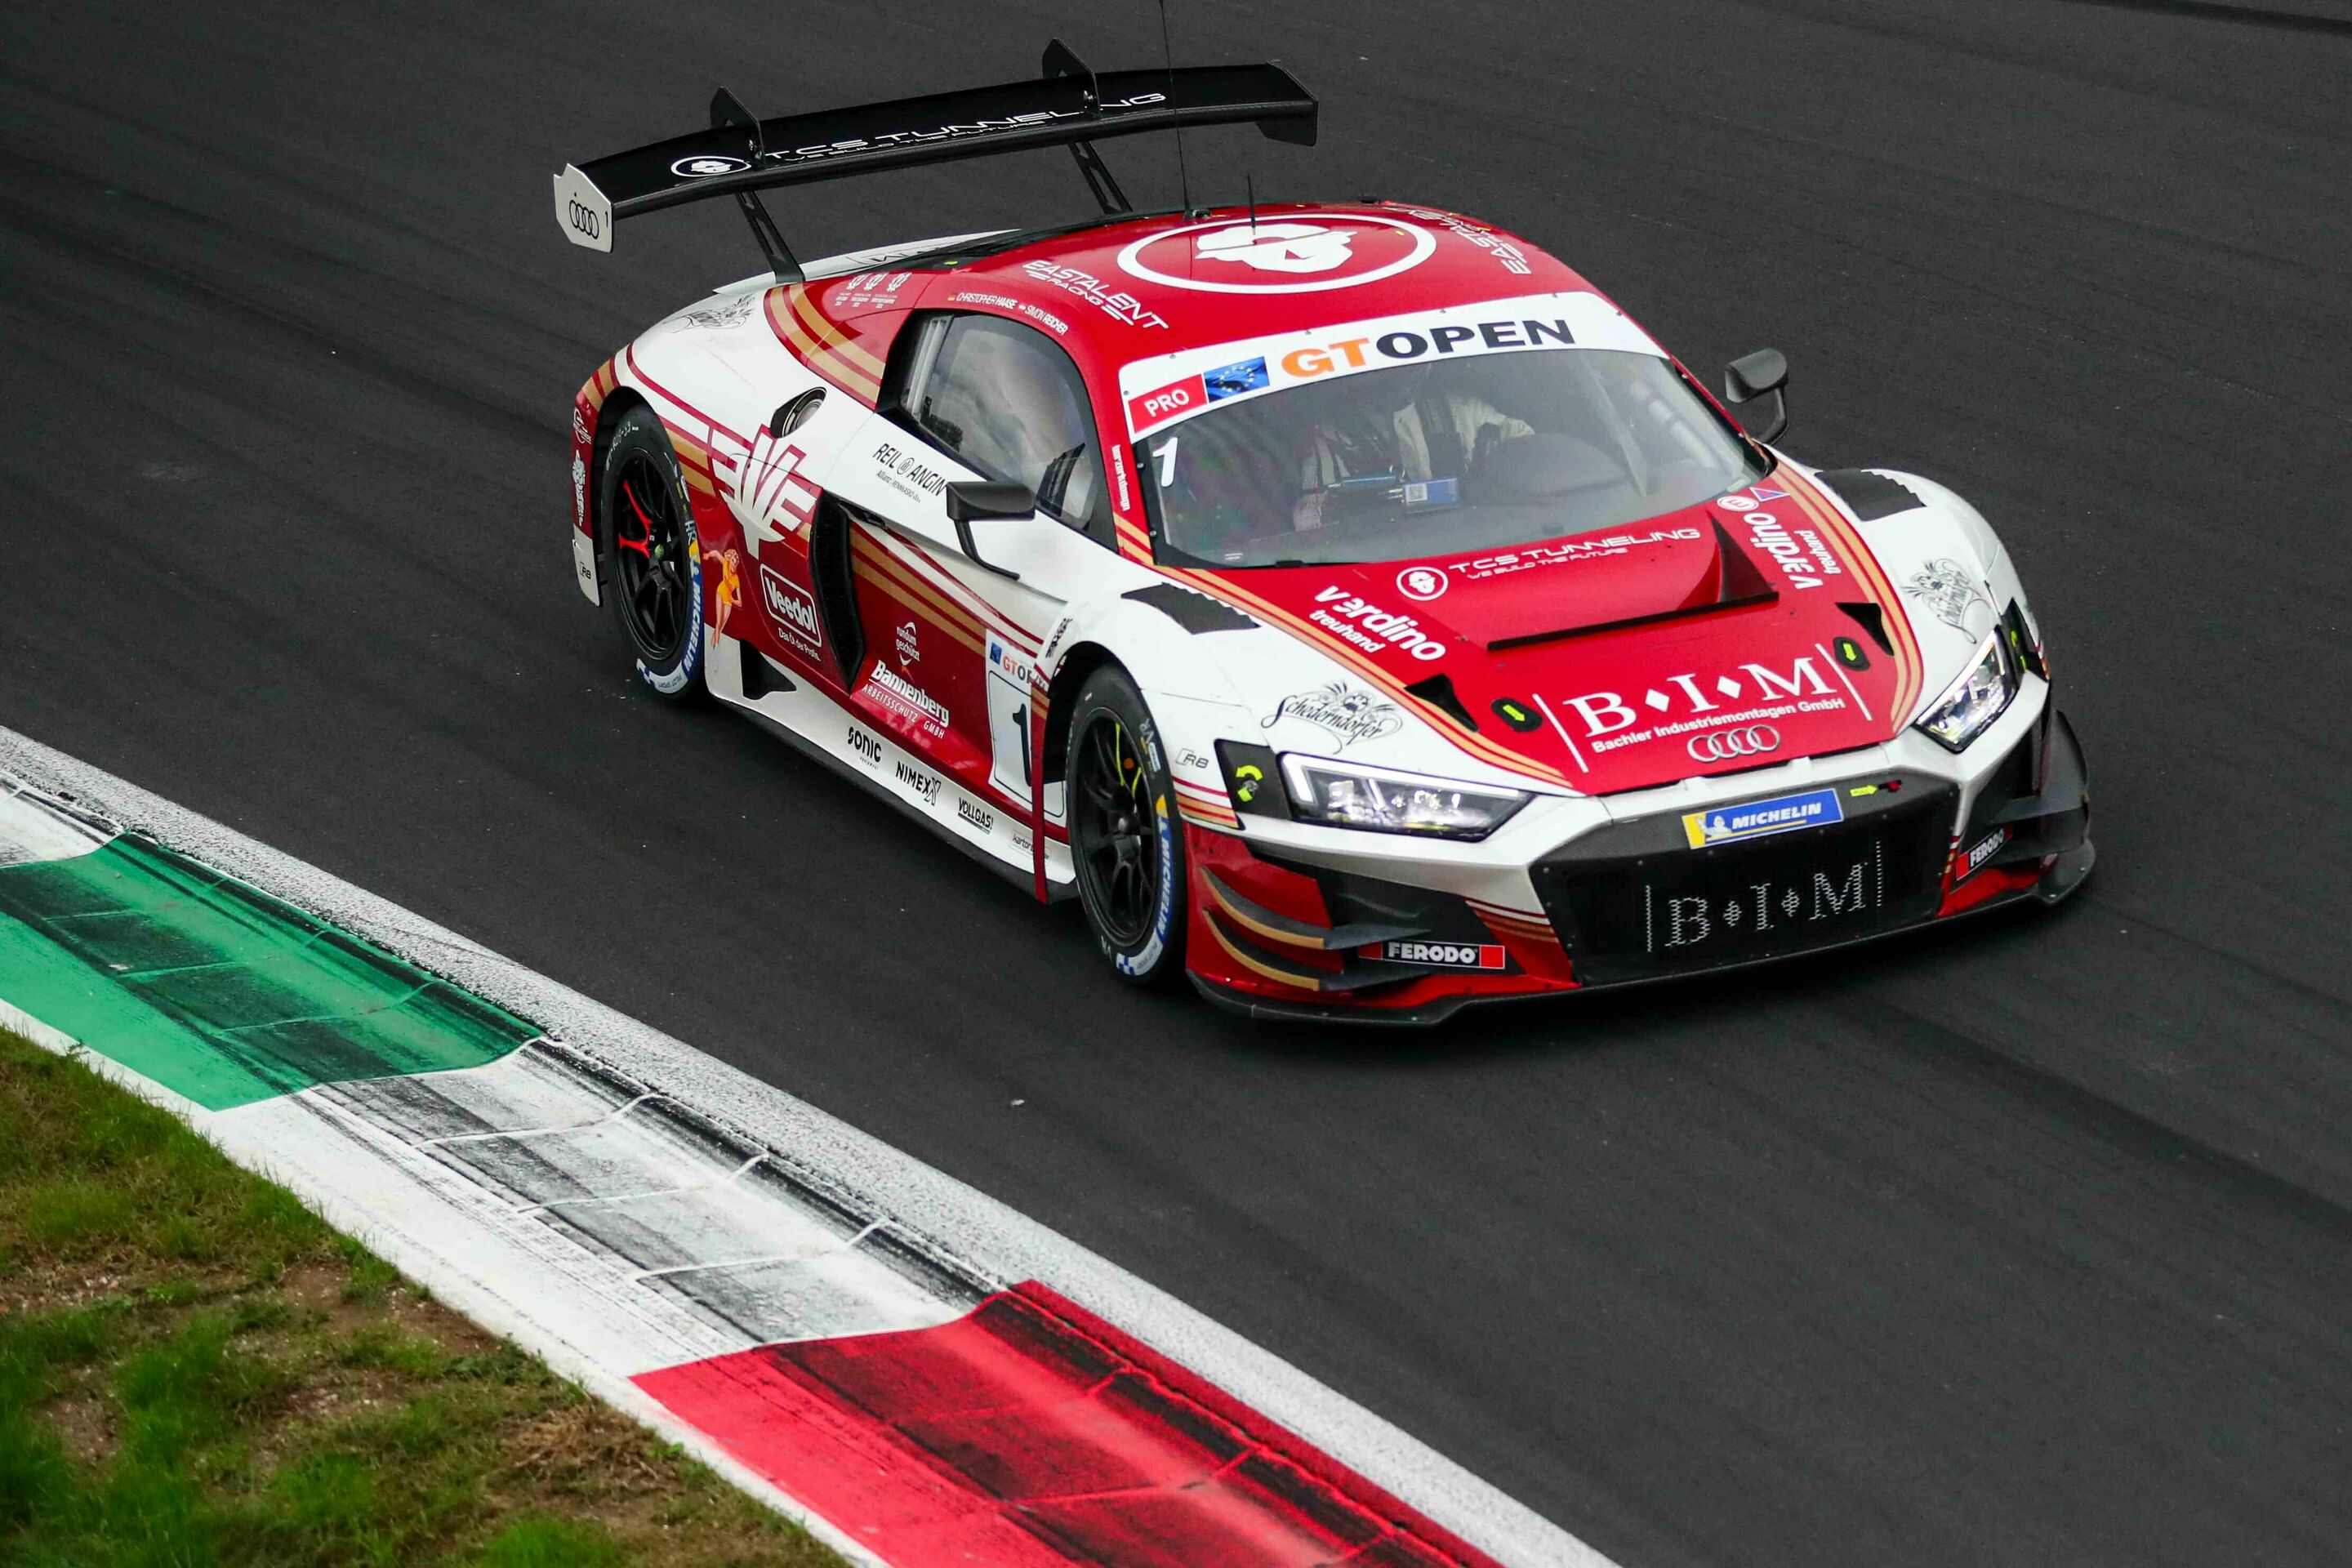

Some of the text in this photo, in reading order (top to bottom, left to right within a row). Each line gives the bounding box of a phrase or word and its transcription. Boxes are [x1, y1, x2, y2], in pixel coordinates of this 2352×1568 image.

[765, 92, 1166, 158] TCS TUNNELNG
[956, 292, 997, 305] CHRISTOPHER
[995, 296, 1018, 310] HAASE
[1025, 305, 1046, 321] SIMON
[1022, 260, 1169, 329] EASTALENT
[1046, 271, 1103, 306] RACING
[1143, 388, 1190, 418] PRO
[872, 443, 902, 469] REIL
[1152, 436, 1179, 488] 1
[1448, 528, 1701, 575] TCS TUNNELING
[1467, 547, 1628, 580] WE BUILD THE FUTURE
[1793, 529, 1842, 575] treuhand
[684, 580, 702, 672] MICHELIN
[764, 576, 817, 635] Veedol
[896, 626, 916, 646] rundum
[1309, 609, 1386, 653] treuhand
[862, 683, 945, 739] ARBEITSSCHUTZ GMBH
[871, 659, 950, 728] Bannenberg
[848, 726, 882, 763] SONIC
[1012, 702, 1032, 786] 1
[1591, 697, 1846, 755] Bachler Industriemontagen GmbH
[958, 796, 994, 831] VOLLGAS!
[1732, 802, 1822, 831] MICHELIN
[1970, 827, 2004, 868] FERODO
[1157, 835, 1171, 936] MICHELIN
[1388, 942, 1477, 964] FERODO
